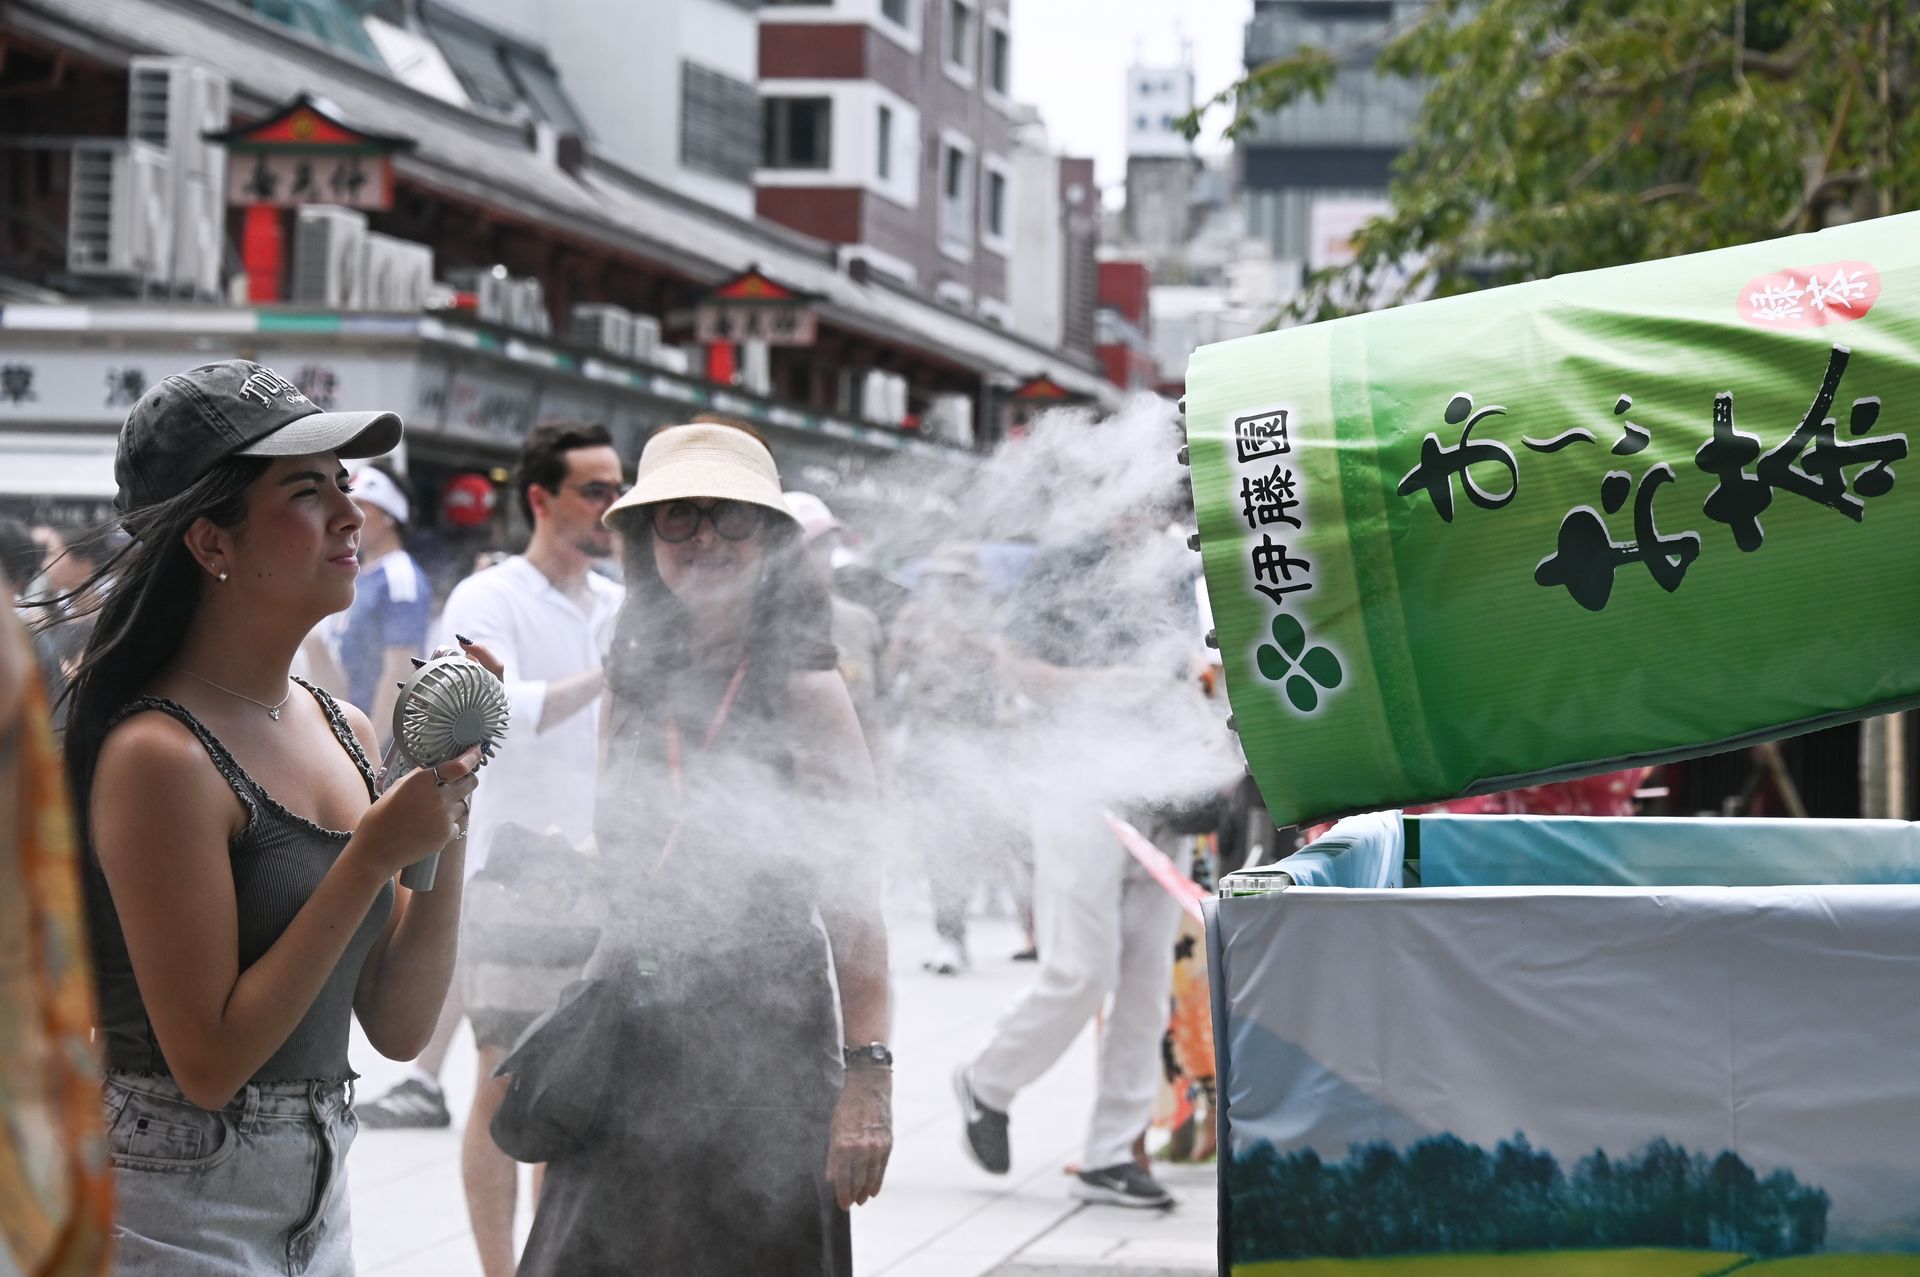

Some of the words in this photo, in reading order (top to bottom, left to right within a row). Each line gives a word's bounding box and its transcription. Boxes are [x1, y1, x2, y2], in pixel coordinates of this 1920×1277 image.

[1749, 268, 1869, 320] 緑茶
[1234, 410, 1313, 605] 伊藤園
